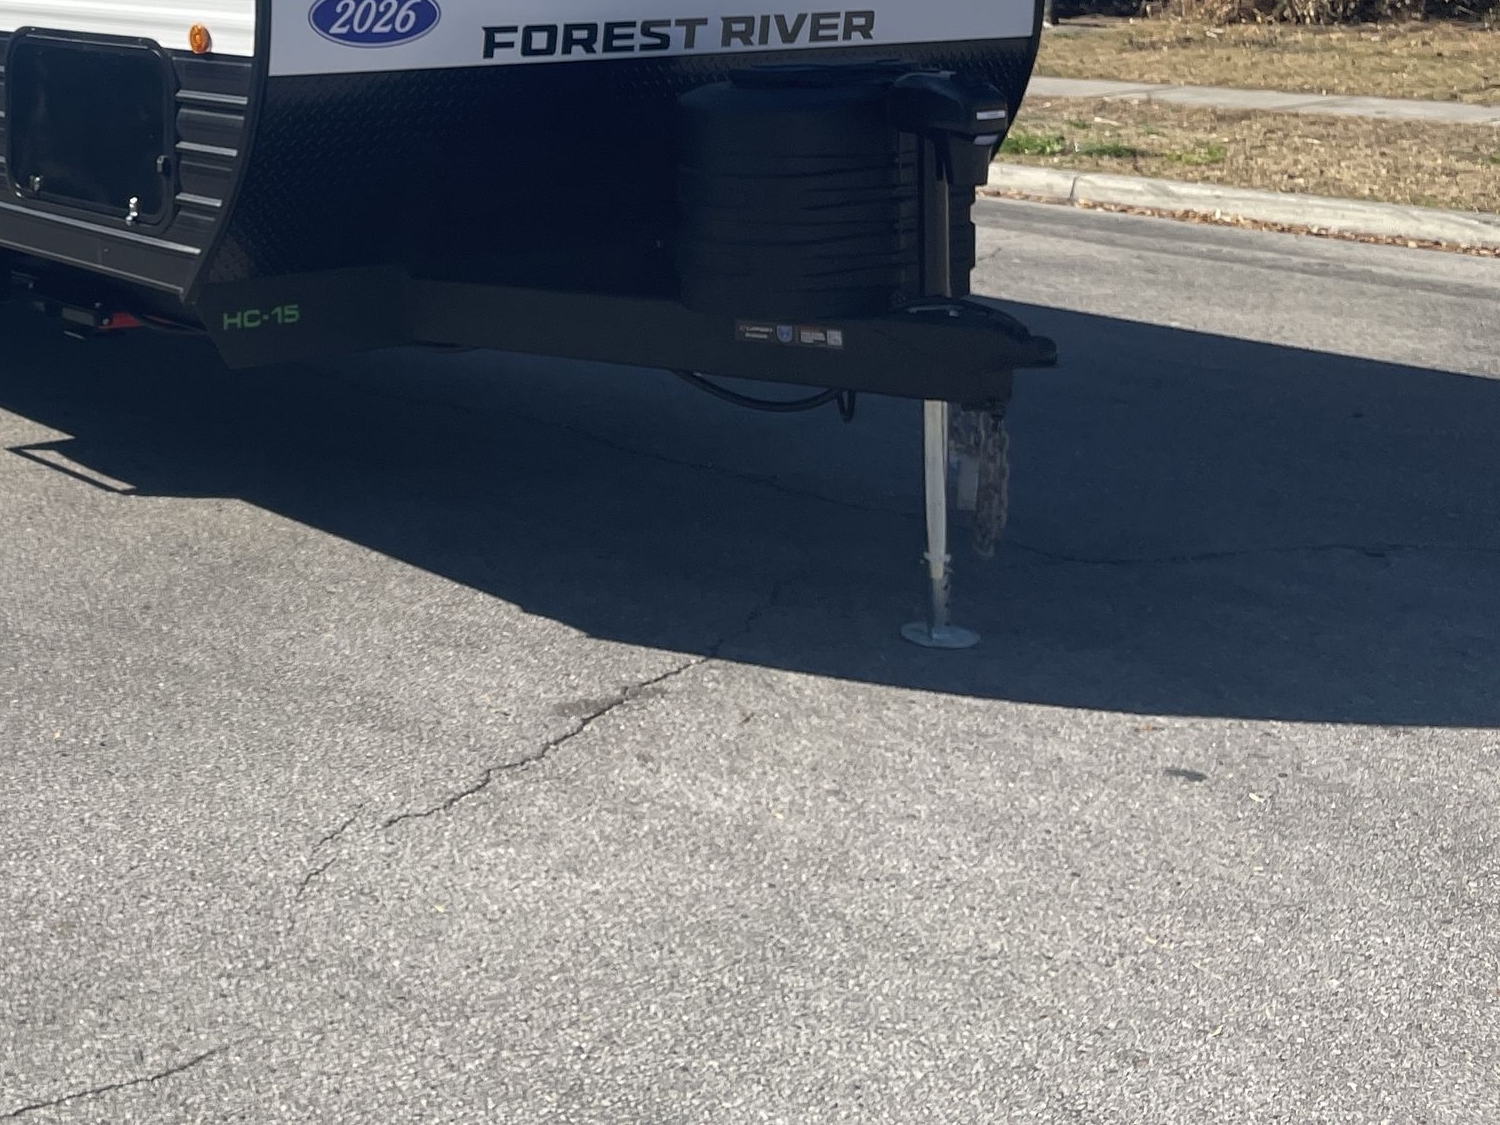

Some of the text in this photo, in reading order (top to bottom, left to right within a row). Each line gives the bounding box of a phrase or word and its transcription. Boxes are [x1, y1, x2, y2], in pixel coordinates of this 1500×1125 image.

[481, 9, 876, 59] FOREST RIVER
[223, 303, 300, 331] HC-15
